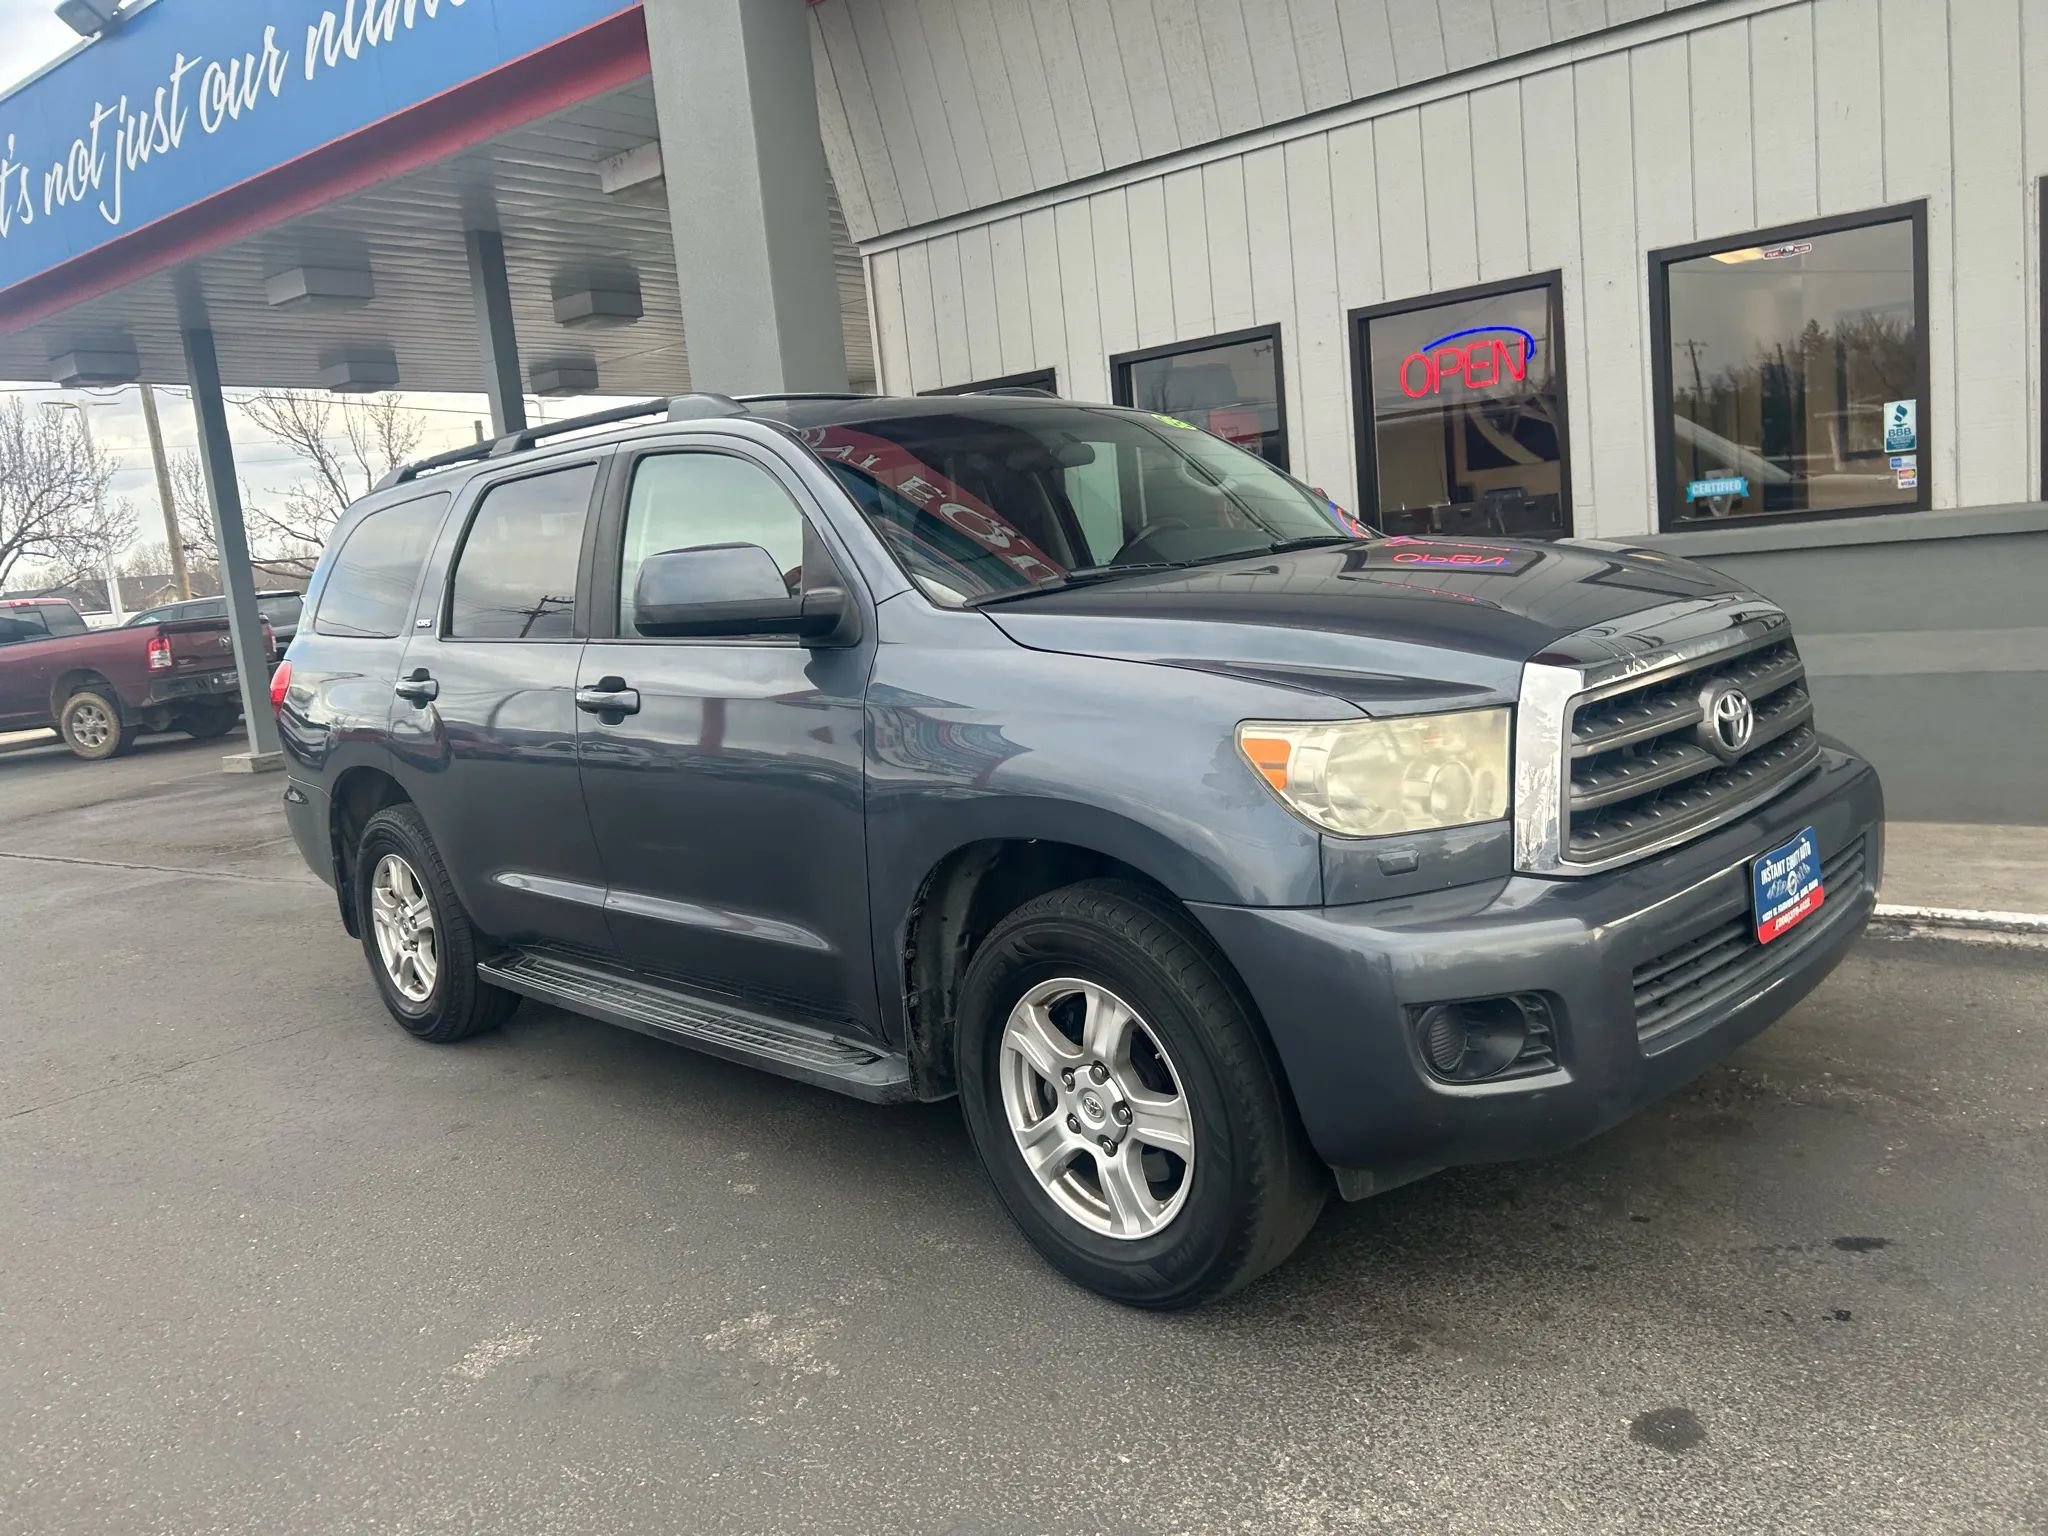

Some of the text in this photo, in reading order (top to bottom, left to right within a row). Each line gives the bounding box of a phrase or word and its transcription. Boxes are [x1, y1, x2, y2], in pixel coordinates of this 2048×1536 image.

[44, 102, 118, 215] not
[99, 53, 202, 224] just
[199, 25, 289, 133] our
[1400, 335, 1526, 399] OPEN
[1888, 427, 1912, 437] BBB
[1693, 479, 1741, 497] CERTIFIED
[1761, 859, 1786, 885] INSTANT
